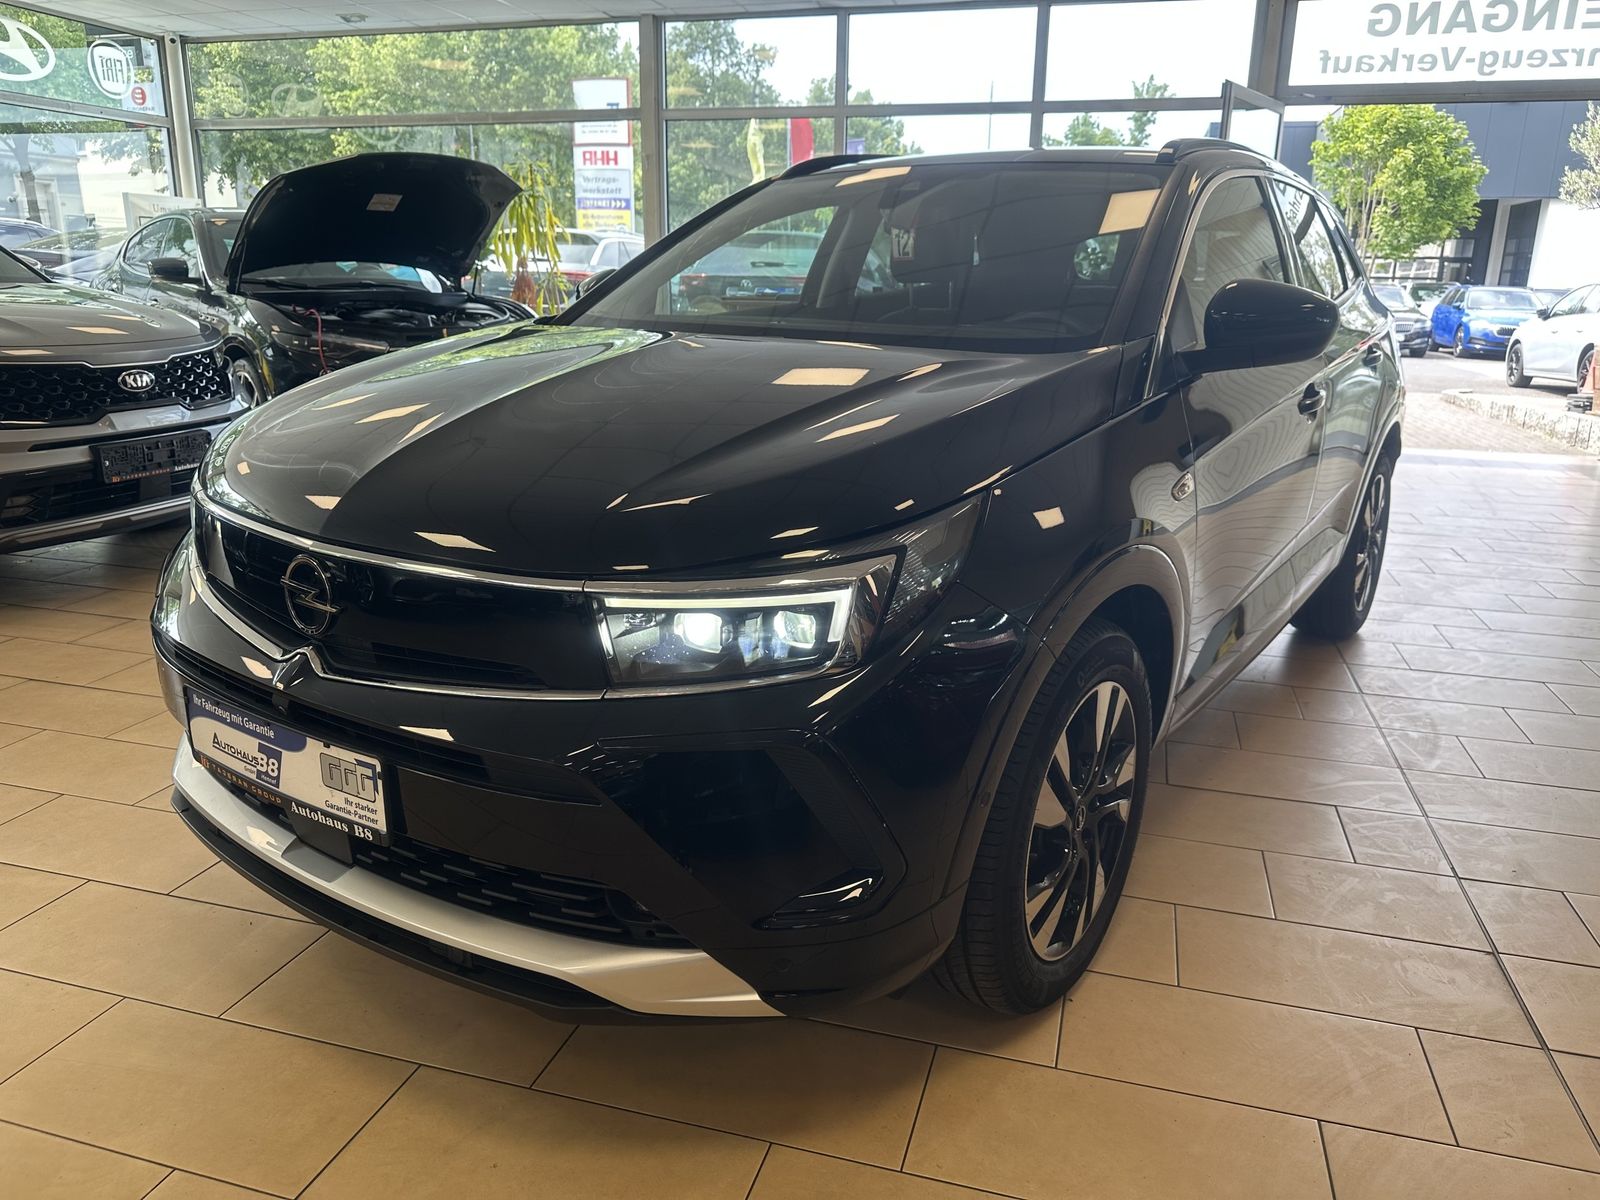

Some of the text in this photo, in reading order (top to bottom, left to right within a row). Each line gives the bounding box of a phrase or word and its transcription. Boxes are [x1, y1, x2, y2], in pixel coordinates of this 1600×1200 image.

[124, 374, 151, 388] KIA
[202, 698, 231, 722] Fahrzeug
[231, 713, 242, 726] mit
[243, 717, 275, 739] Garantie
[324, 799, 379, 825] Garantie-Partner
[343, 797, 378, 816] Ihr starker
[290, 801, 374, 841] Autohaus B8
